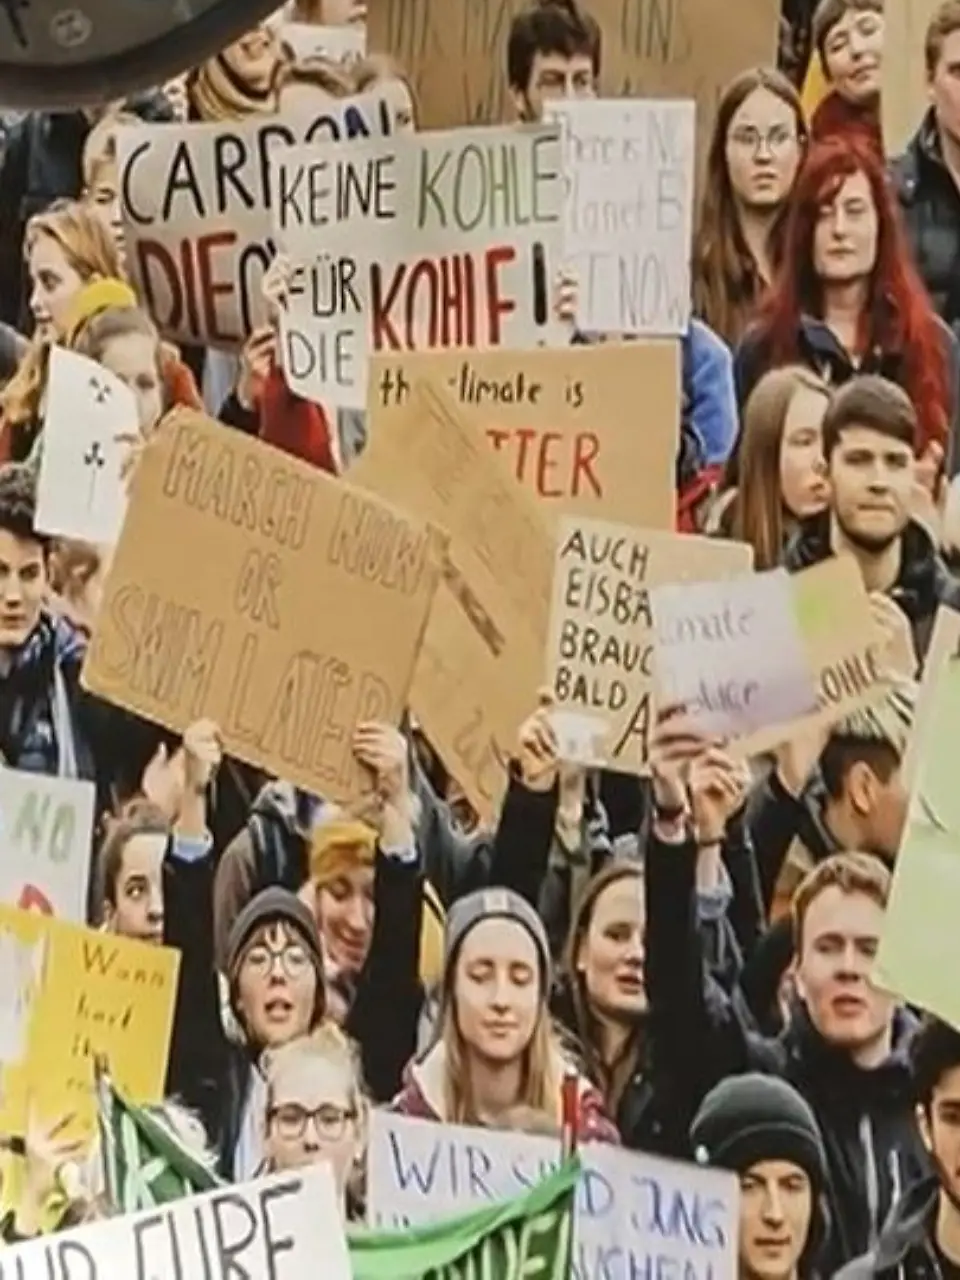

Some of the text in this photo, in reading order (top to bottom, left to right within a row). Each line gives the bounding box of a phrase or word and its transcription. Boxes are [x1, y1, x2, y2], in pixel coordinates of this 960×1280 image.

[280, 133, 560, 233] KEINE KOHLE
[286, 327, 356, 389] DIE
[380, 361, 585, 409] th limate is
[163, 424, 314, 552] MARCH
[328, 492, 433, 598] NOW
[235, 547, 283, 631] OR
[560, 527, 649, 581] AUCH
[106, 583, 225, 718] SWIM
[553, 666, 628, 711] BALD
[388, 1129, 500, 1202] WIR
